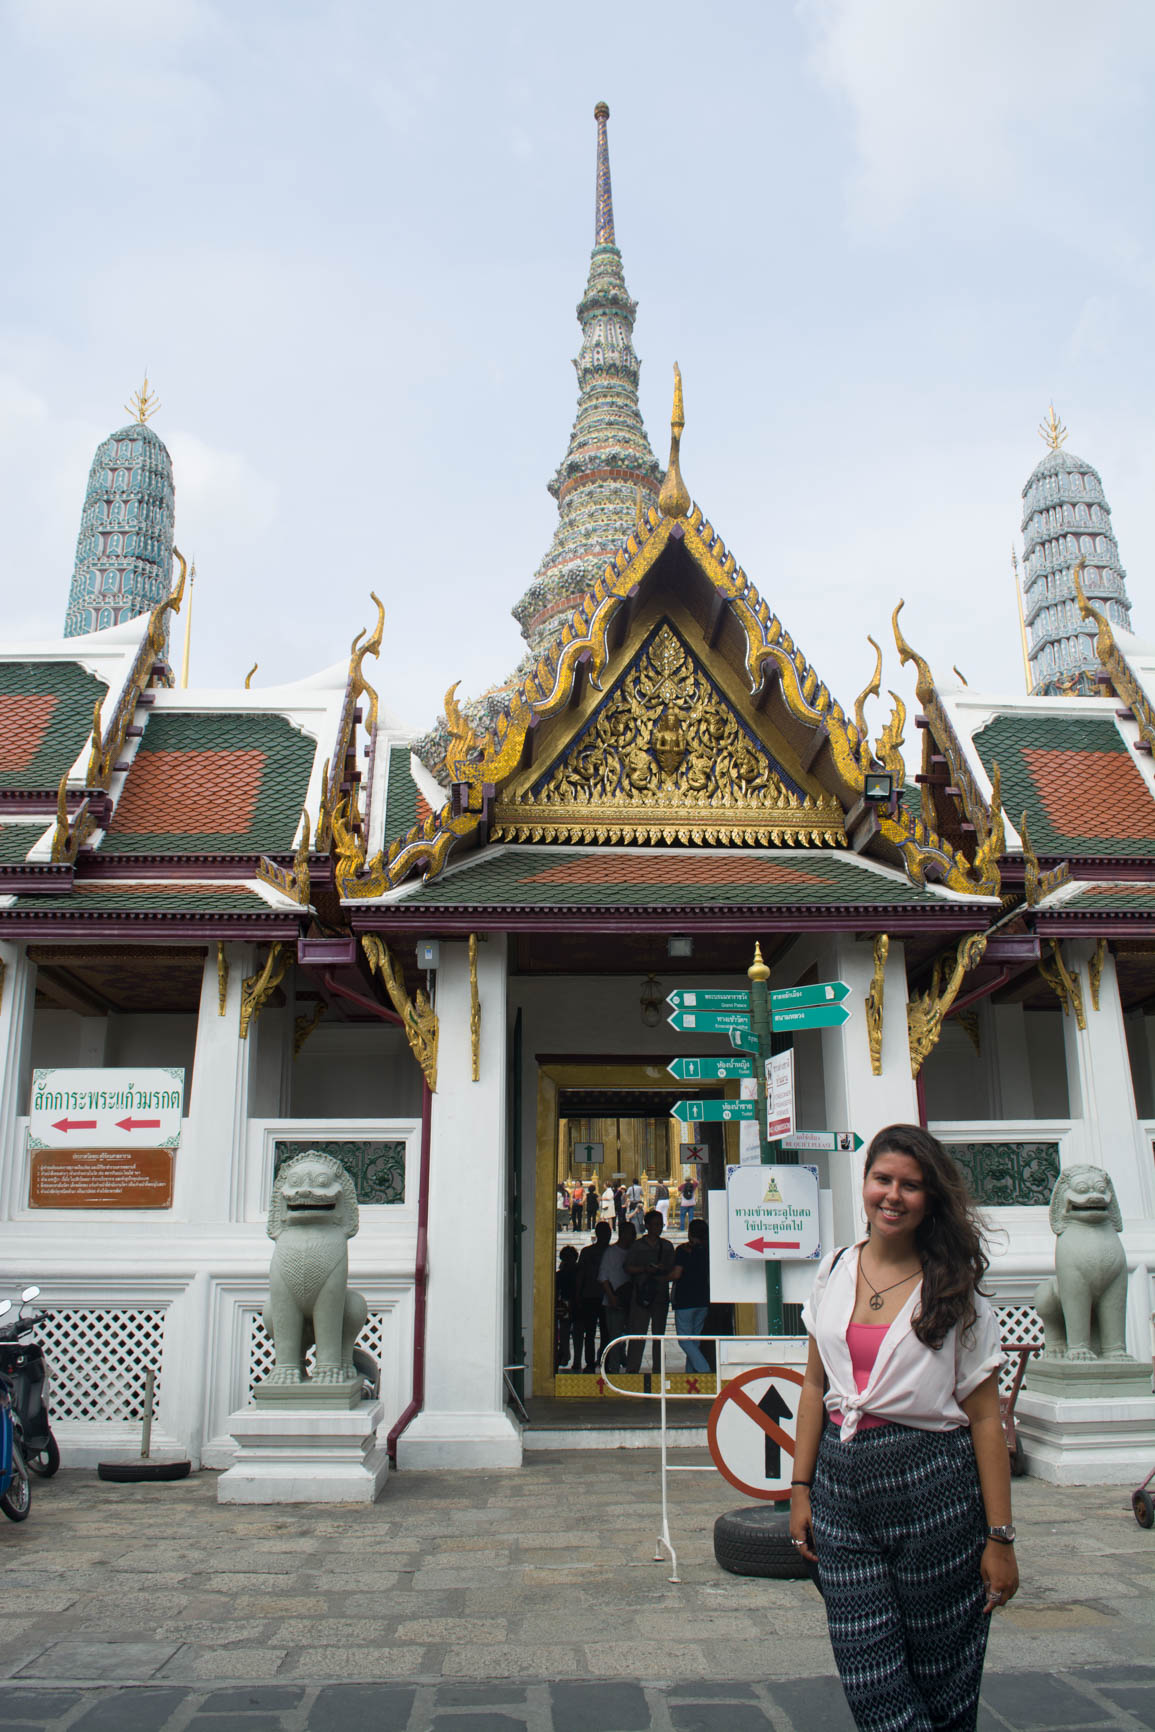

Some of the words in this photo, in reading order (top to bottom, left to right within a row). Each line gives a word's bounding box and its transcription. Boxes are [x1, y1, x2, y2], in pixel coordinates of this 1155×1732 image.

[716, 1058, 750, 1070] ห้องน้ำหญิง
[34, 1082, 180, 1111] สักการะพระแก้วมรกต
[722, 1100, 752, 1110] ห้องน้ำชาย
[735, 1205, 811, 1220] ทางเข้าพระอุโบสถ
[744, 1220, 803, 1234] ใช้ประตูถัดไป
